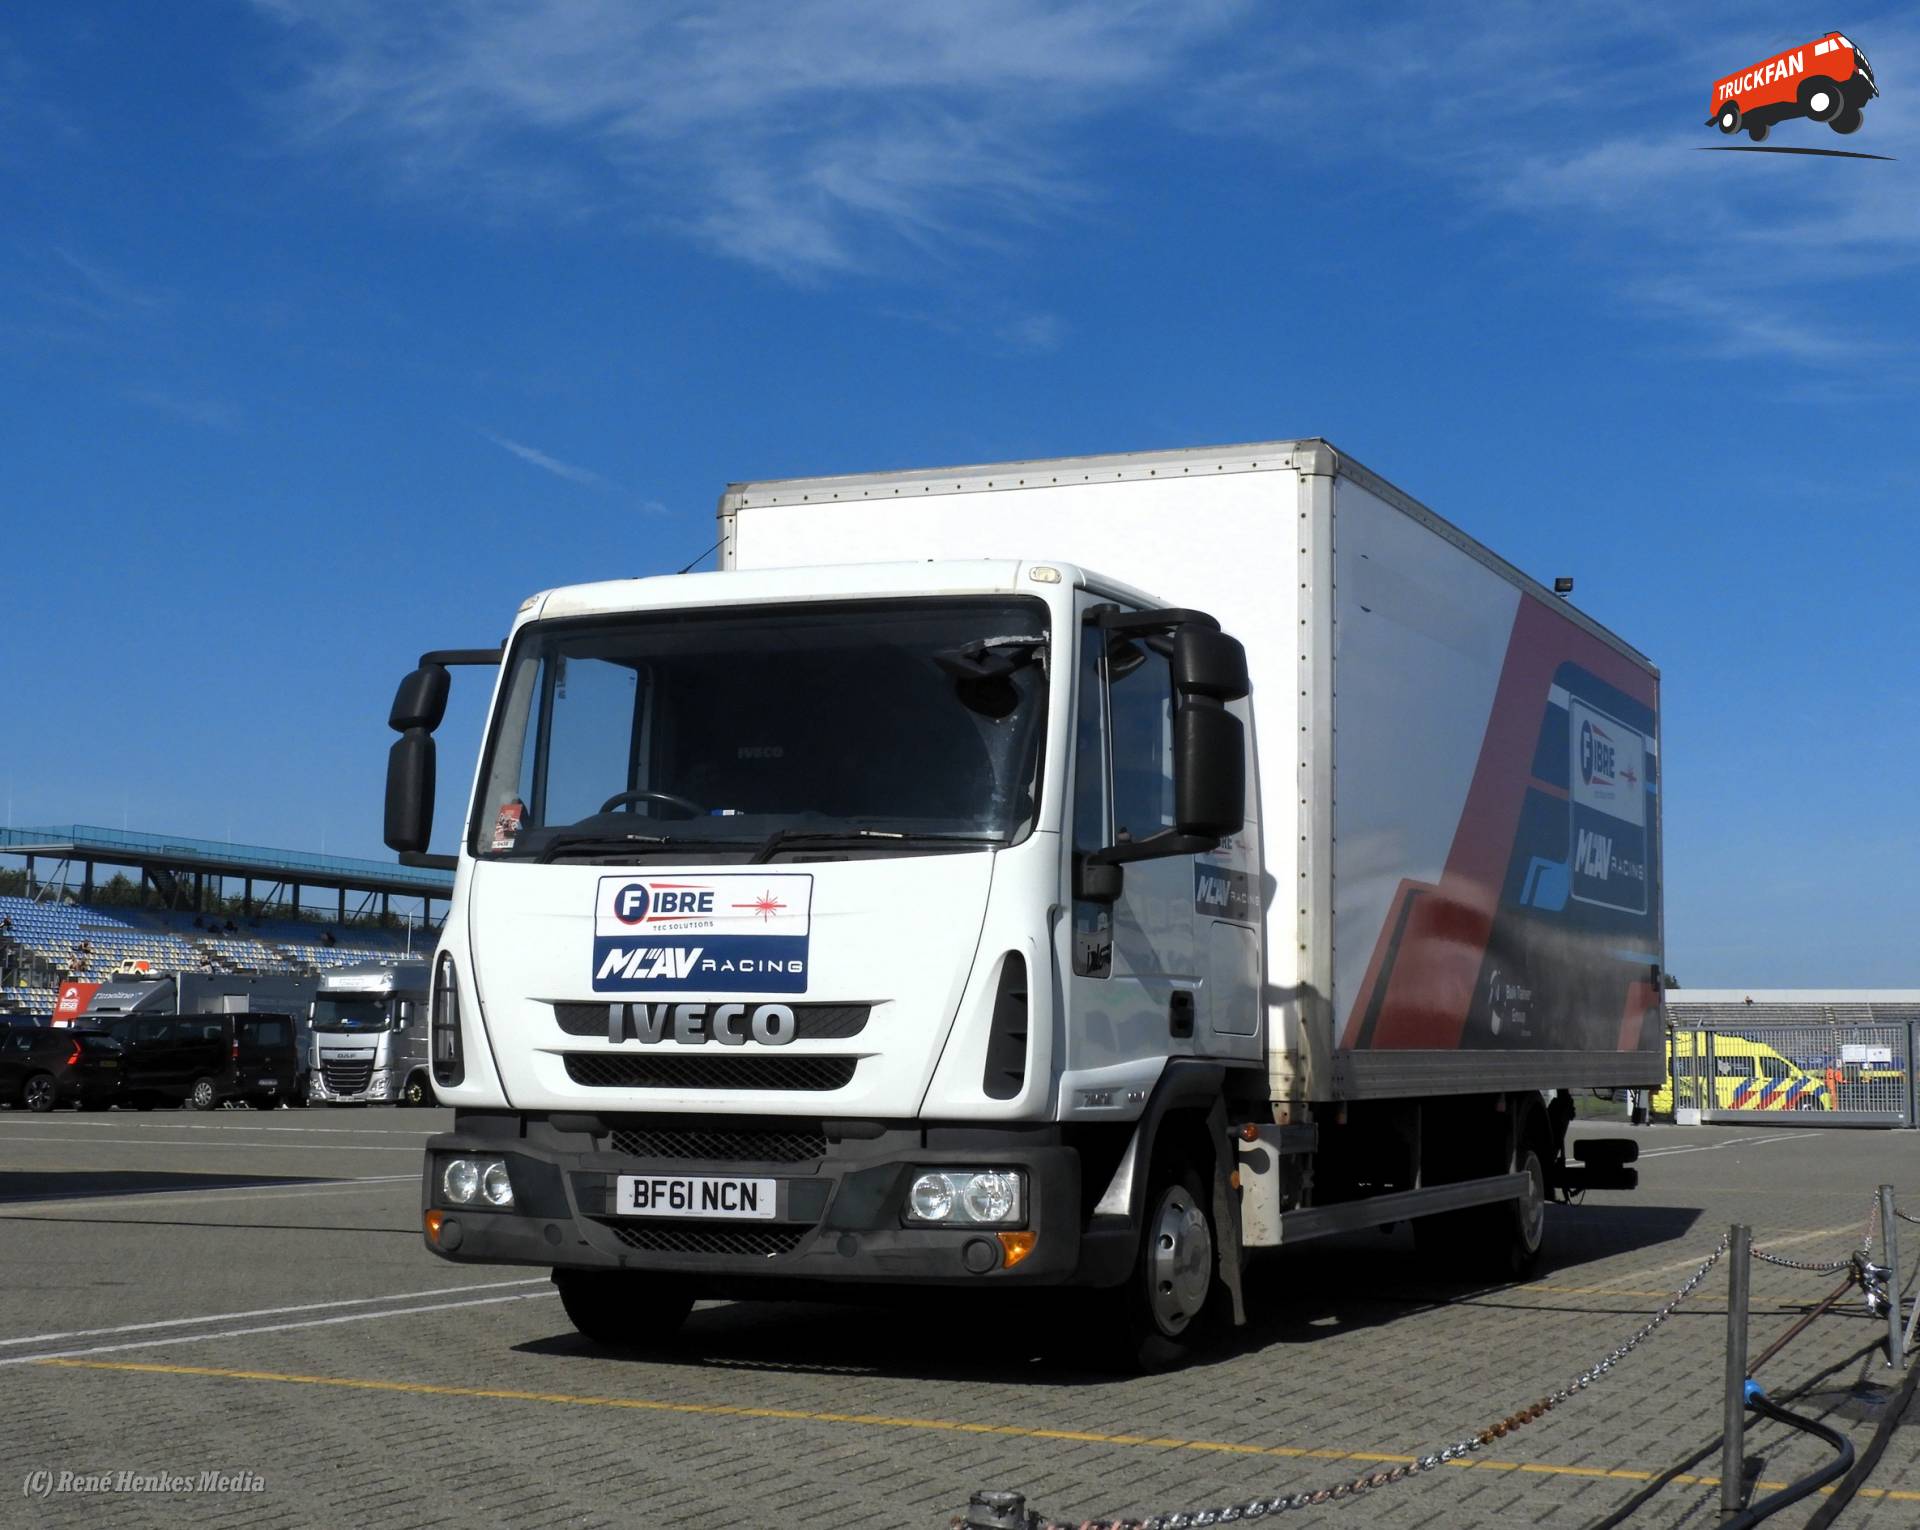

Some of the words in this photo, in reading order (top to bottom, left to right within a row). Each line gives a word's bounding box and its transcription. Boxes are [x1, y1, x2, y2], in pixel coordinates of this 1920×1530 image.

[737, 746, 784, 759] IVECO
[1583, 731, 1615, 779] FIBRE
[620, 888, 714, 917] FIBRE
[669, 921, 714, 930] SOLUTIONS
[702, 959, 803, 973] RACING
[608, 1003, 798, 1046] IVECO
[633, 1180, 693, 1210] BF61
[702, 1181, 757, 1211] NCN
